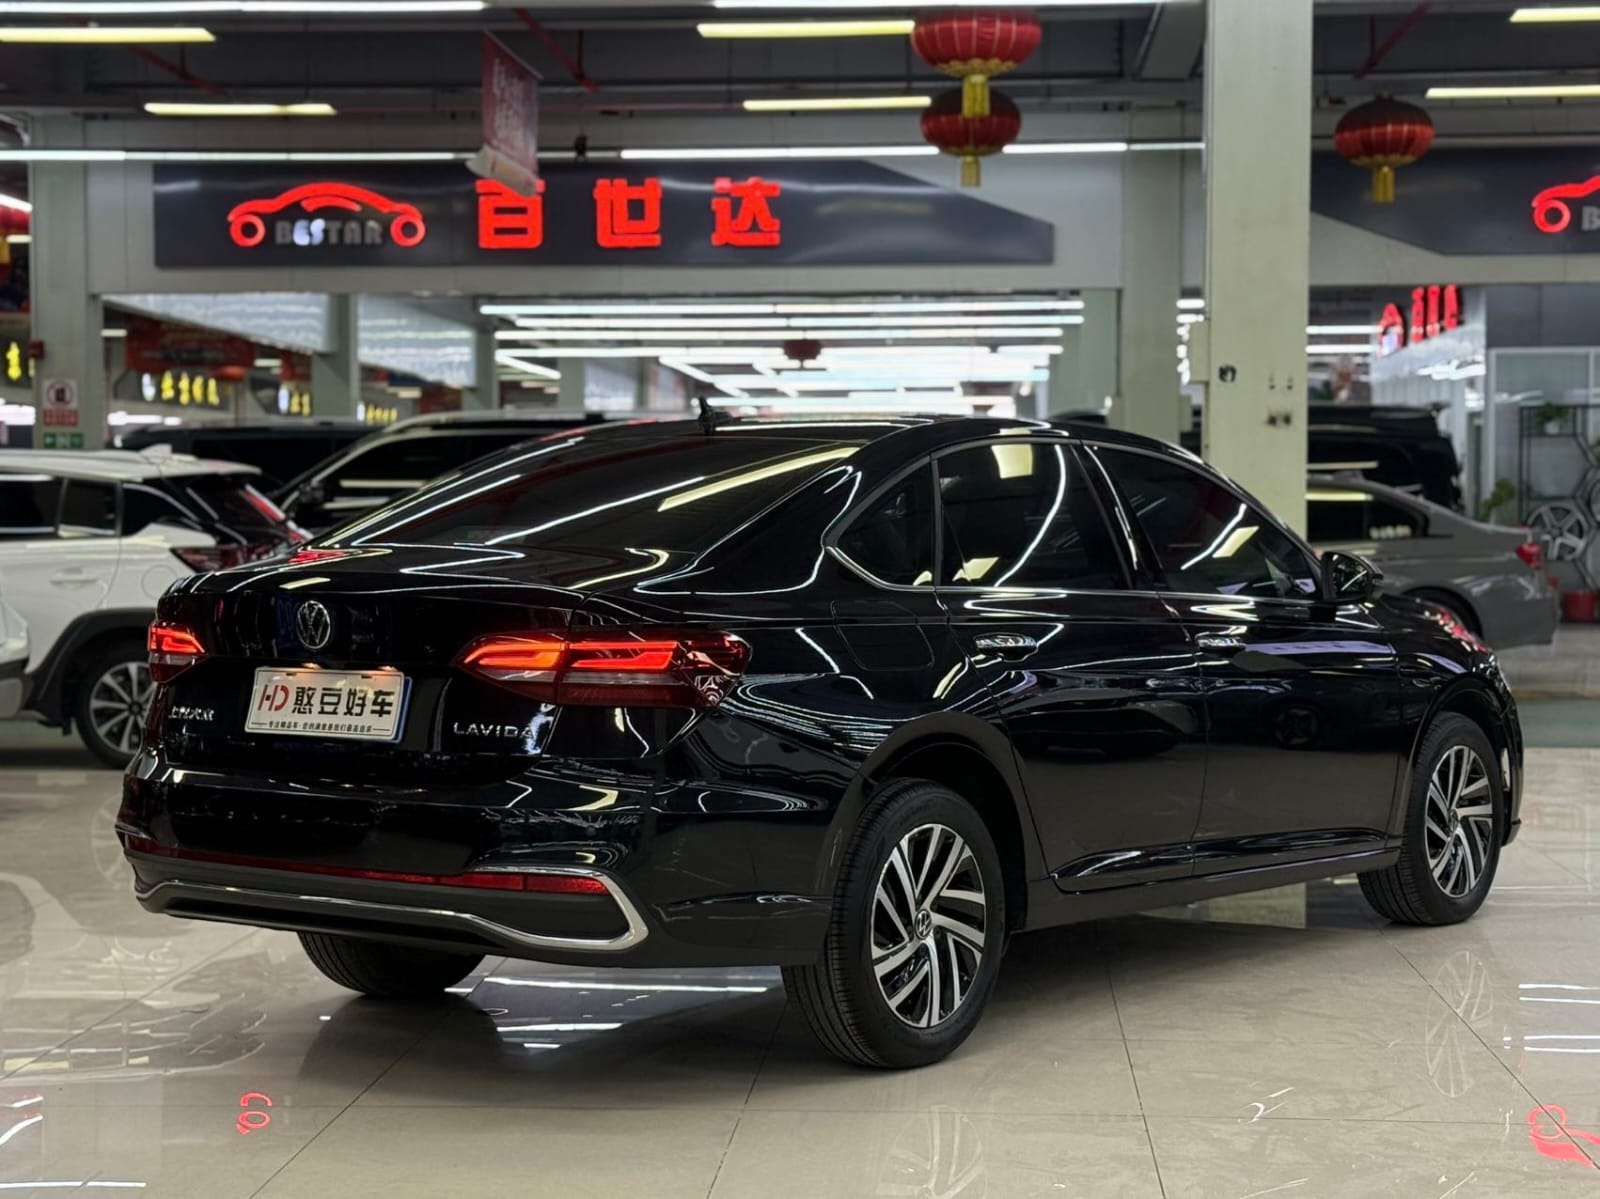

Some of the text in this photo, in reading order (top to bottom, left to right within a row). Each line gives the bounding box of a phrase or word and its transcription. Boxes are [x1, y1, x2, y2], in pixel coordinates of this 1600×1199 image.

[275, 218, 382, 246] BESTAR
[291, 686, 395, 717] 憨豆好车
[453, 722, 534, 738] LAVIDA
